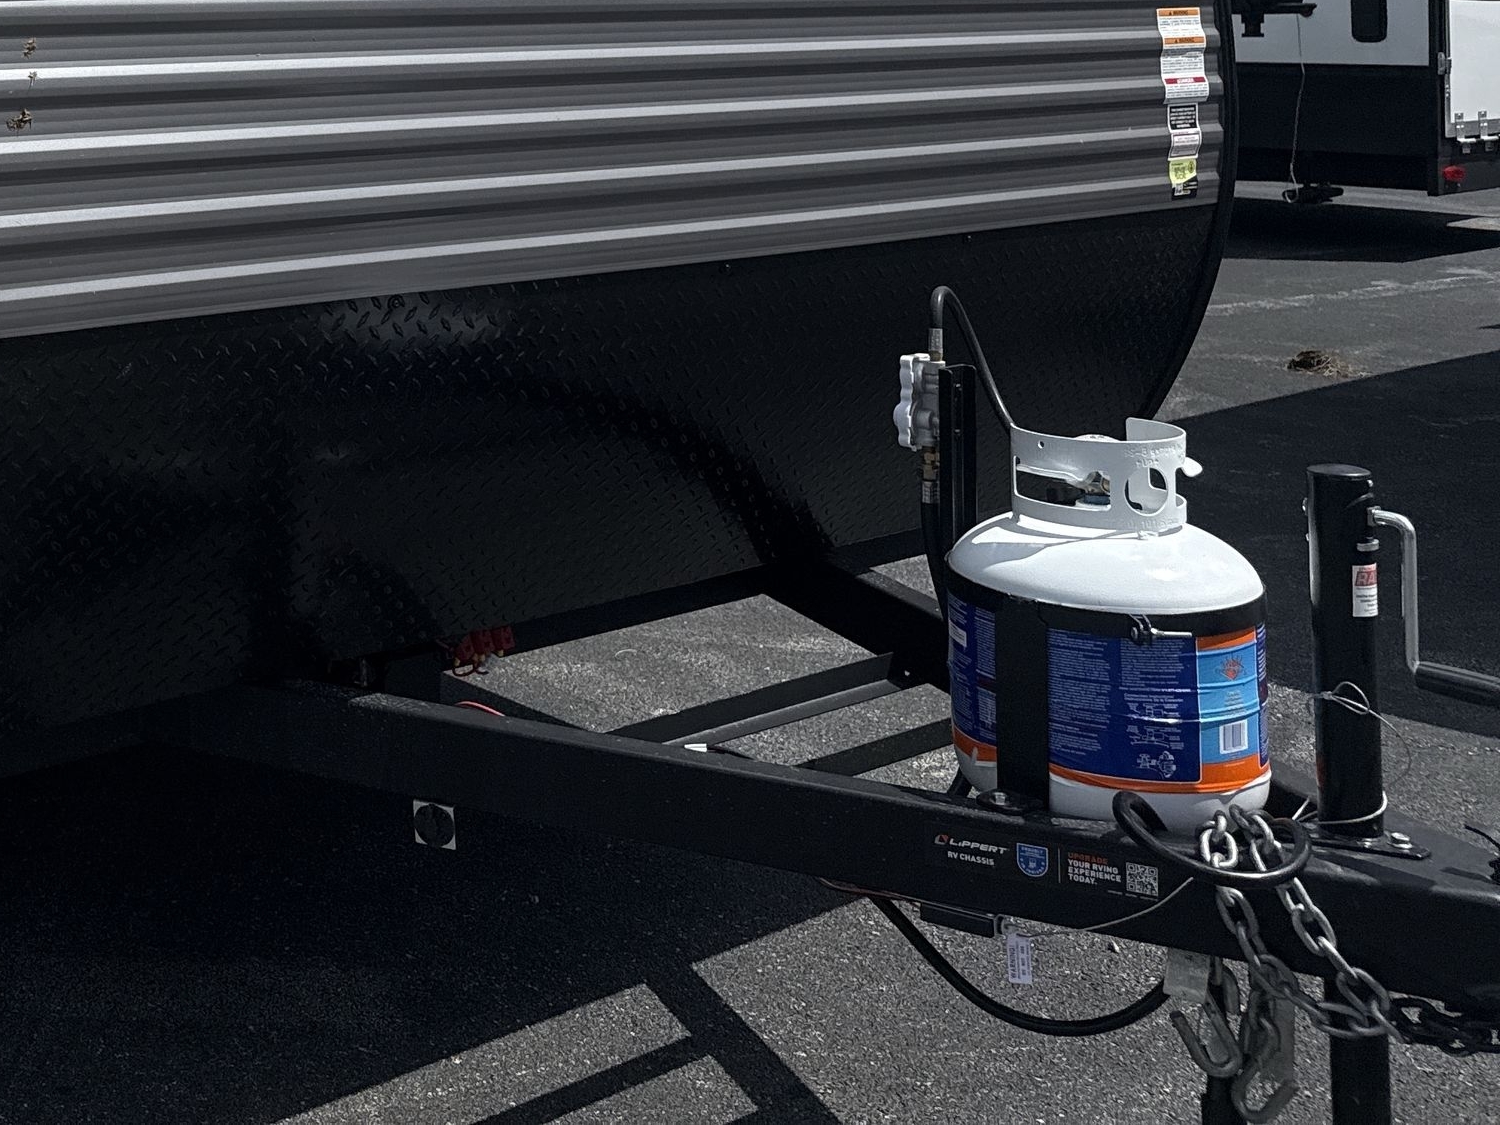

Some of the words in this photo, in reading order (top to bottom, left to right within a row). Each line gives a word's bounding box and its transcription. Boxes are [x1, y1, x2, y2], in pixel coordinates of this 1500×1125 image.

[947, 850, 959, 861] RV
[959, 853, 995, 866] CHASSIS
[1067, 851, 1109, 864] UPGRADE
[1067, 858, 1091, 870] YOUR
[1092, 863, 1119, 875] RVING
[1067, 866, 1122, 883] EXPERIENCE
[1067, 873, 1098, 885] TODAY.
